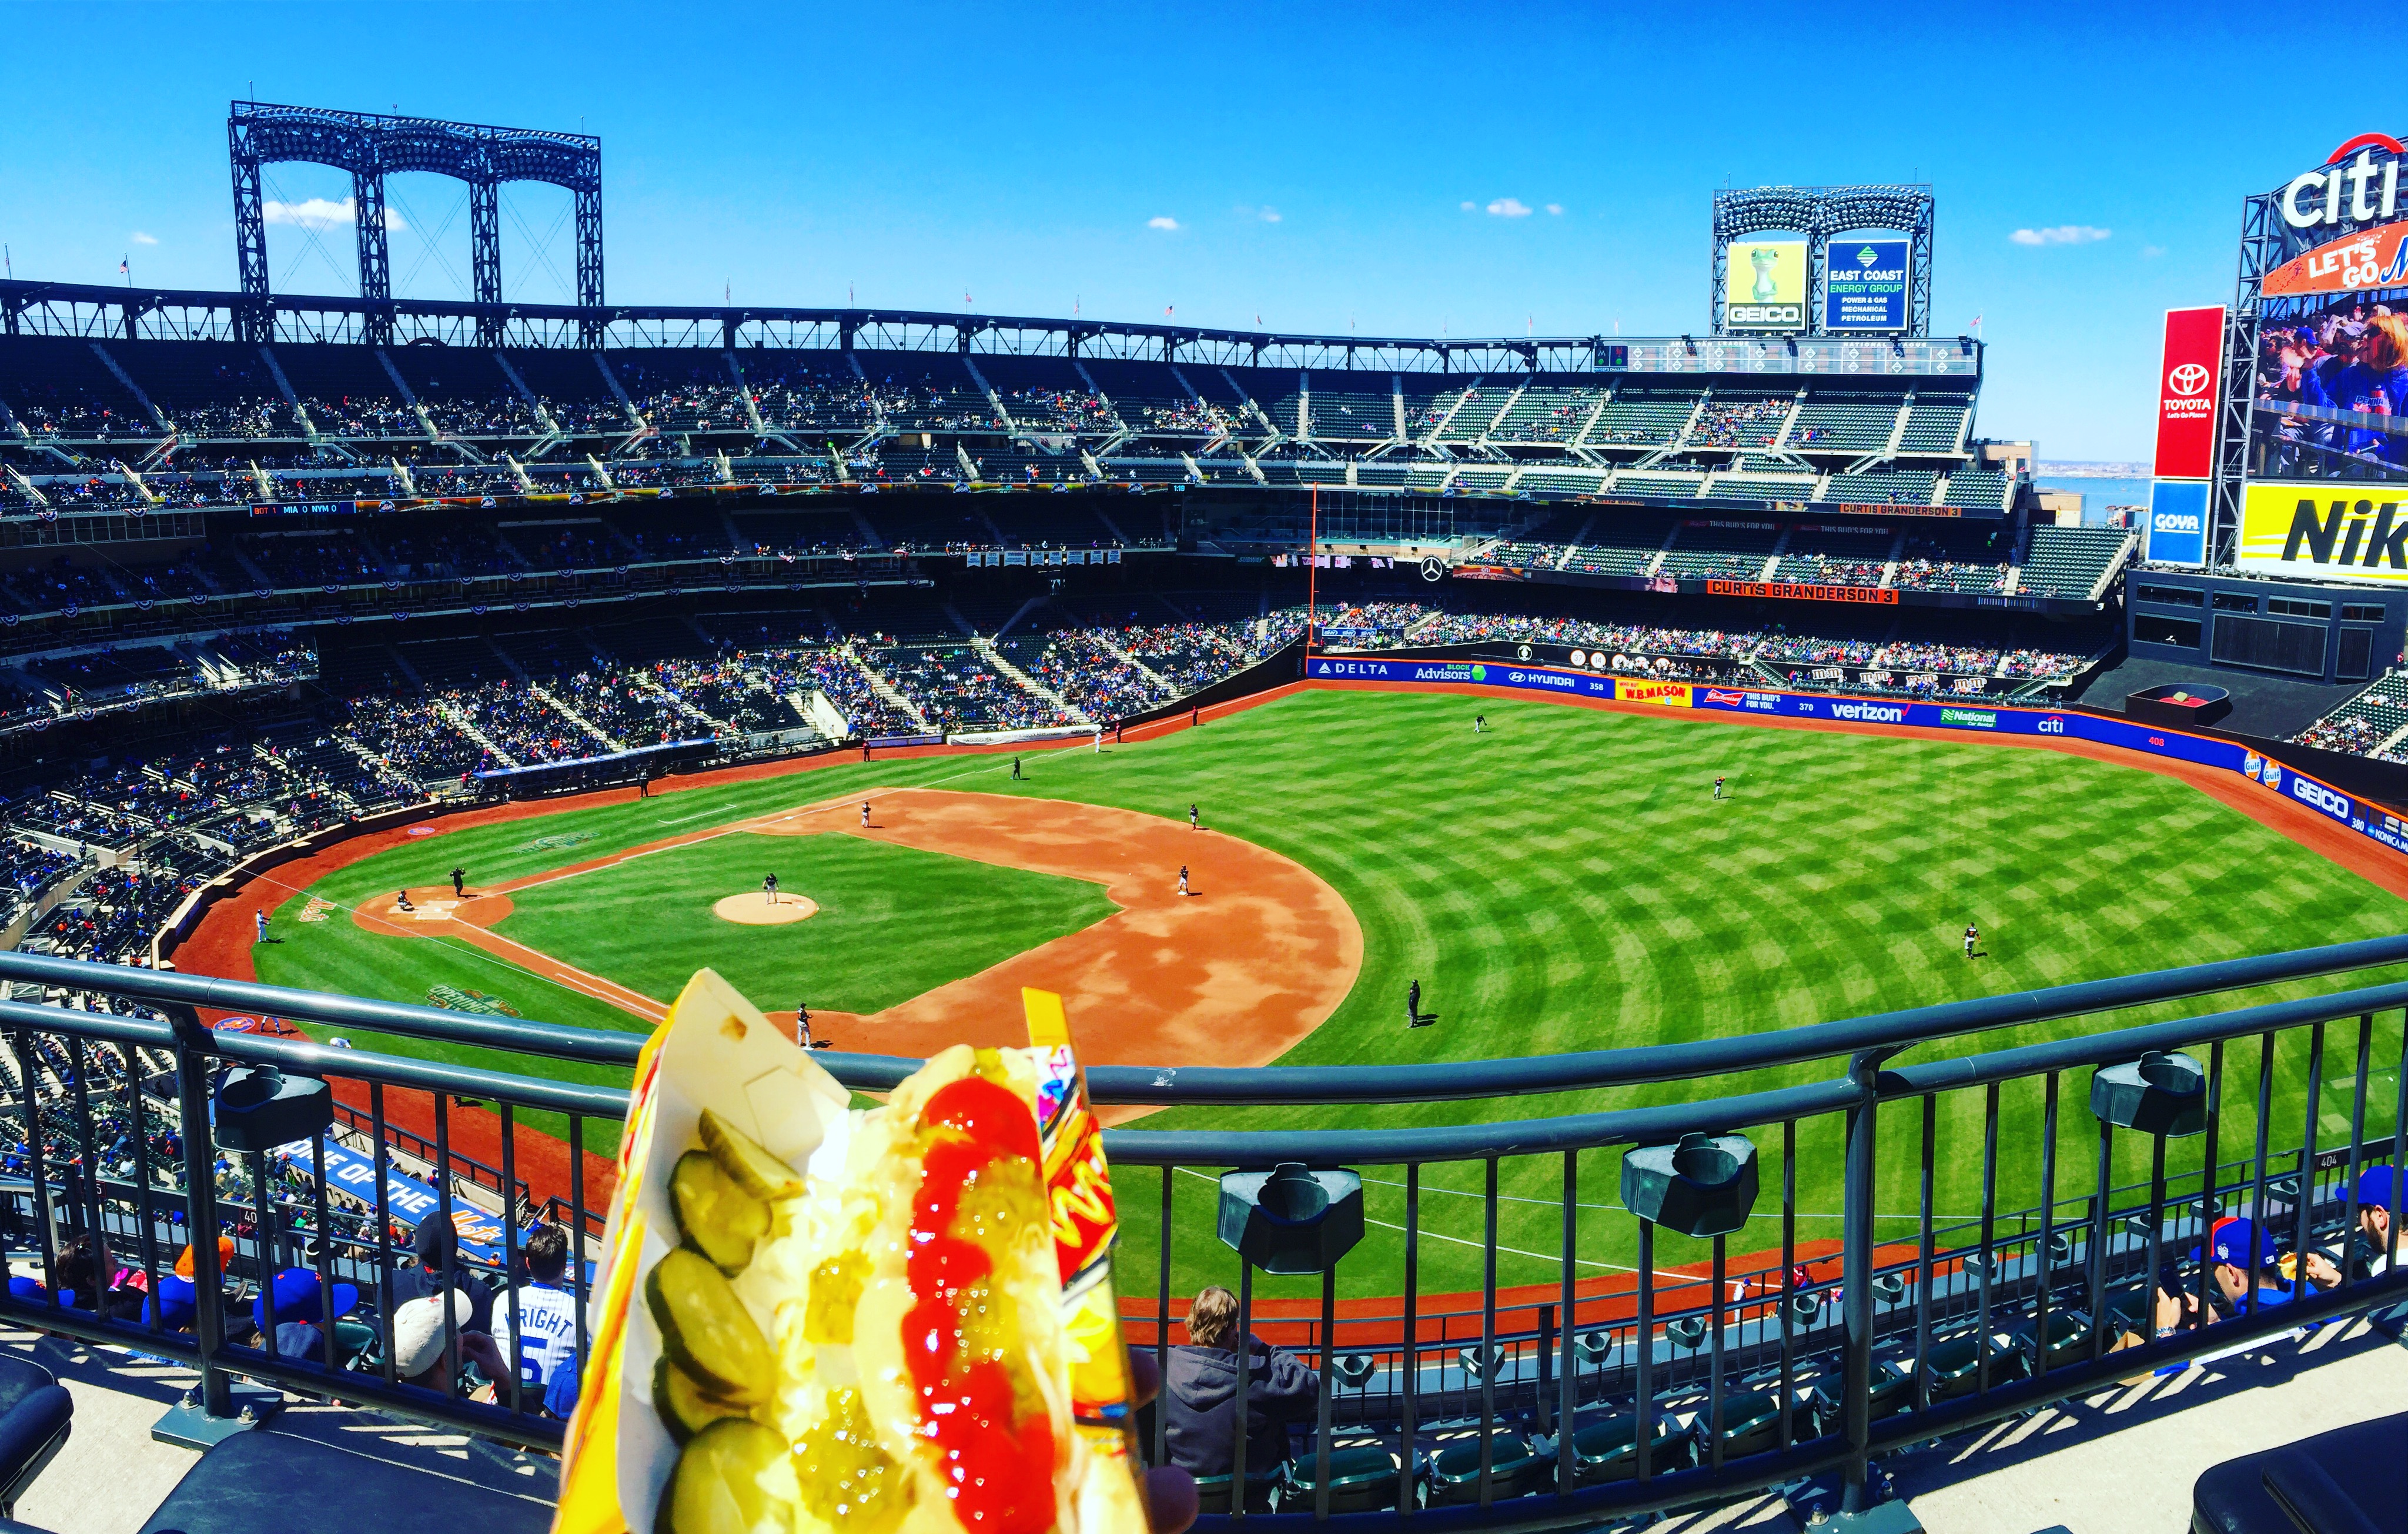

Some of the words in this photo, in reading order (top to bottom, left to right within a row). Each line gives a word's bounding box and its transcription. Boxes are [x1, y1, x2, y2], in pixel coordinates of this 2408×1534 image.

[2283, 149, 2399, 228] citi
[2309, 239, 2376, 278] LET'S
[1830, 270, 1861, 281] EAST
[1864, 270, 1904, 281] COAST
[2343, 261, 2379, 288] GO
[1830, 285, 1867, 293] ENERGY
[1869, 285, 1902, 293] GROUP
[1730, 307, 1800, 322] GEICO
[2163, 399, 2211, 410] TOYOTA
[1843, 504, 1878, 513] CURTIS
[1881, 505, 1948, 516] GRANDERSON
[1951, 508, 1958, 516] 3
[2155, 513, 2199, 530] GOYA
[1713, 581, 1765, 596] CURTIS
[1772, 584, 1878, 601] GRANDERSON
[1884, 590, 1893, 602] 3
[1336, 663, 1388, 674] DELTA
[1416, 668, 1470, 680] Advisors
[1529, 674, 1574, 687] HYUNDAI
[1708, 691, 1740, 701] Budweiser
[1746, 692, 1761, 701] THIS
[1761, 693, 1781, 702] BUD'S
[1831, 702, 1902, 722] verizon
[1954, 710, 1995, 723] National
[2038, 718, 2063, 733] citi
[2149, 736, 2165, 747] 408
[2246, 761, 2260, 770] Gulf
[2265, 771, 2280, 780] Gulf
[2293, 777, 2349, 819] GEICO
[2352, 817, 2364, 831] 380
[2375, 828, 2400, 848] KONICA
[429, 985, 490, 1014] OPENING
[2321, 1155, 2337, 1168] 404
[337, 1163, 376, 1184] OF
[387, 1179, 437, 1214] THE
[244, 1212, 257, 1224] 40
